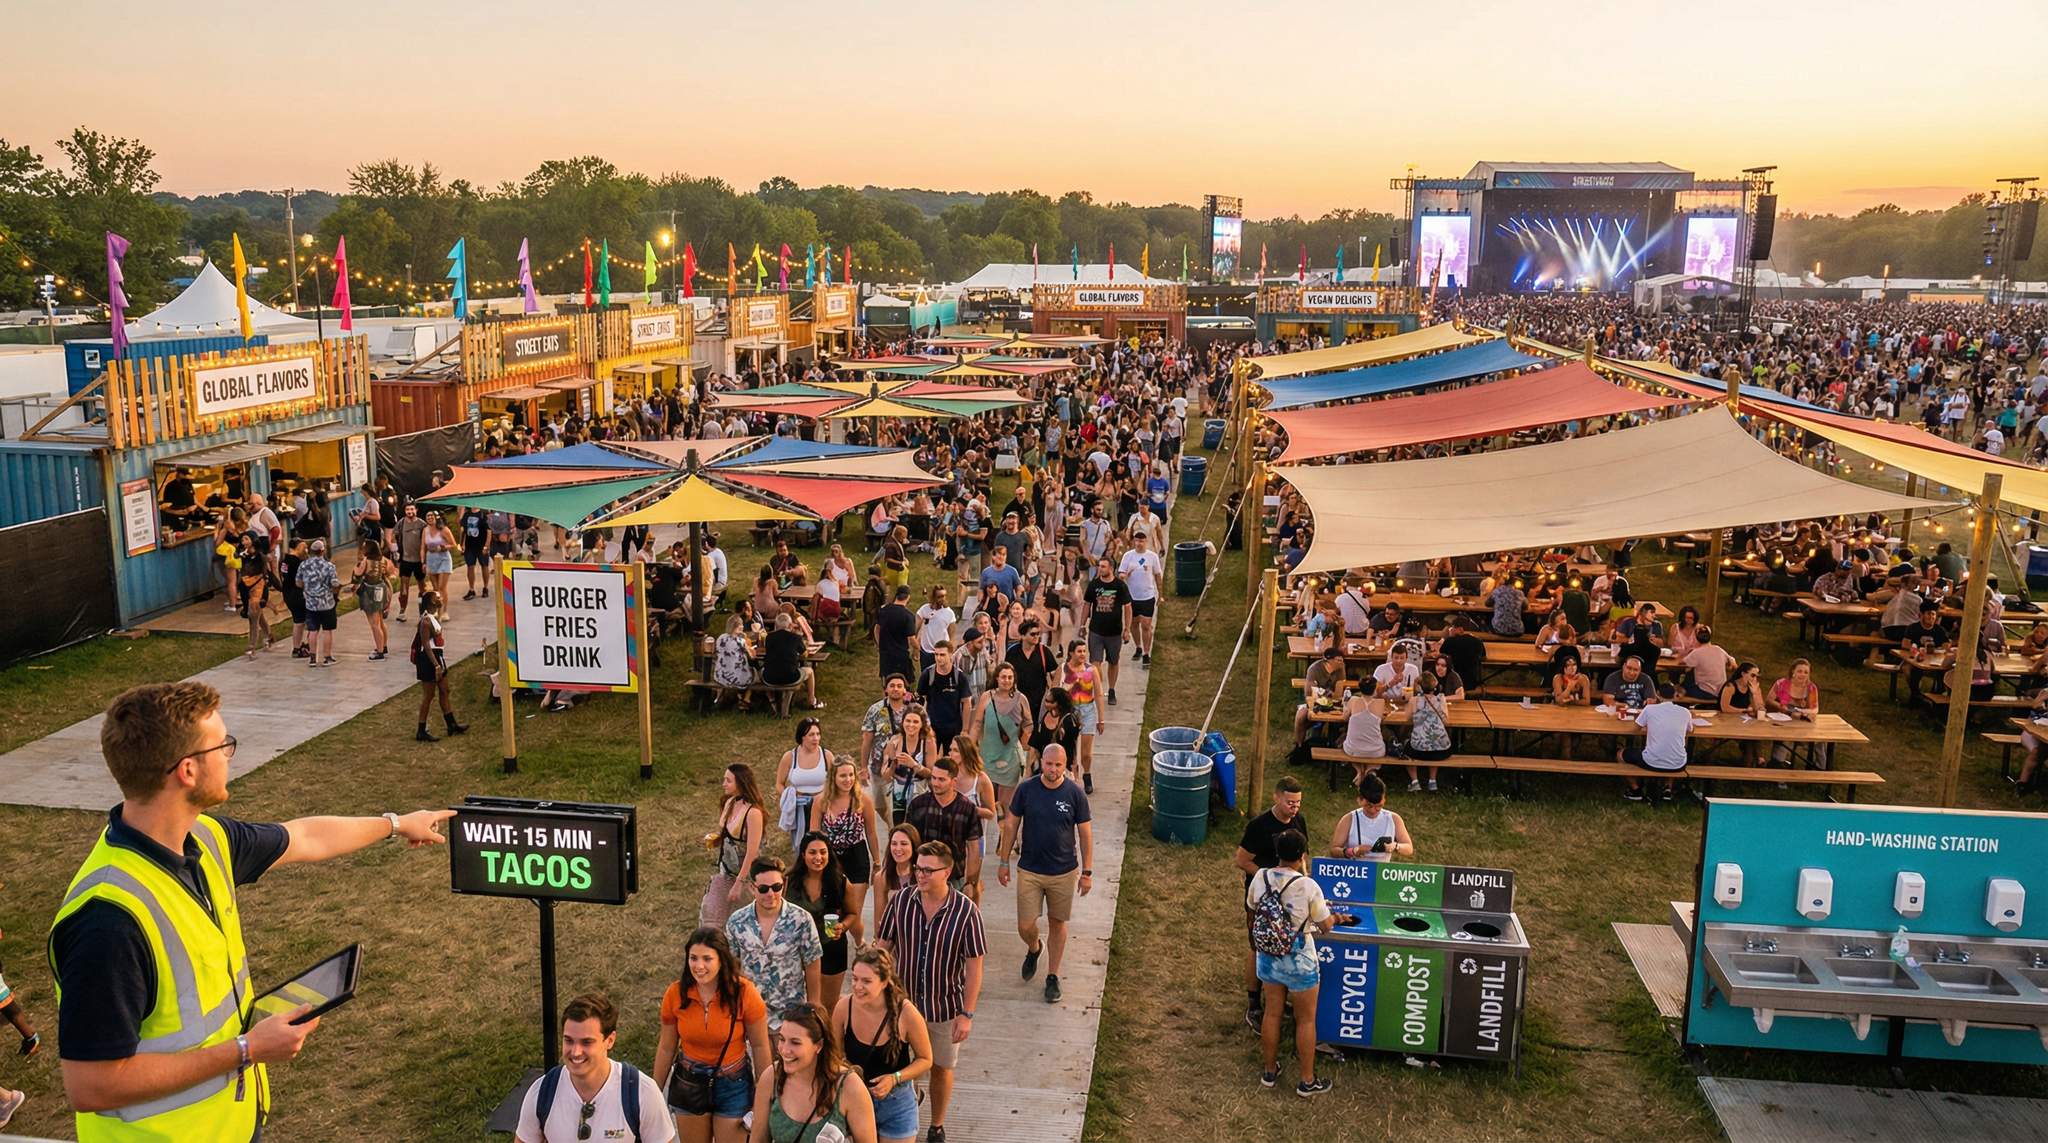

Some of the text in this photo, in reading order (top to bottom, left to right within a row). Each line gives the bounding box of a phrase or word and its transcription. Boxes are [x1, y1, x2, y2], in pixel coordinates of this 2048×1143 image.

[1308, 295, 1372, 304] VEGAN DELIGHTS
[202, 367, 309, 403] GLOBAL FLAVORS
[531, 586, 607, 610] BURGER
[544, 616, 598, 639] FRIES
[543, 645, 602, 668] DRINK
[463, 822, 518, 845] WAIT:
[523, 826, 547, 848] 15
[553, 828, 592, 850] MIN
[1826, 830, 1999, 853] HAND-WASHING STATION
[480, 850, 592, 890] TACOS
[1318, 864, 1369, 879] RECYCLE
[1382, 869, 1438, 884] COMPOST
[1451, 873, 1506, 889] LANDFILL
[1339, 948, 1368, 1039] RECYCLE
[1402, 955, 1431, 1046] COMPOST
[1476, 961, 1506, 1052] LANDFILL
